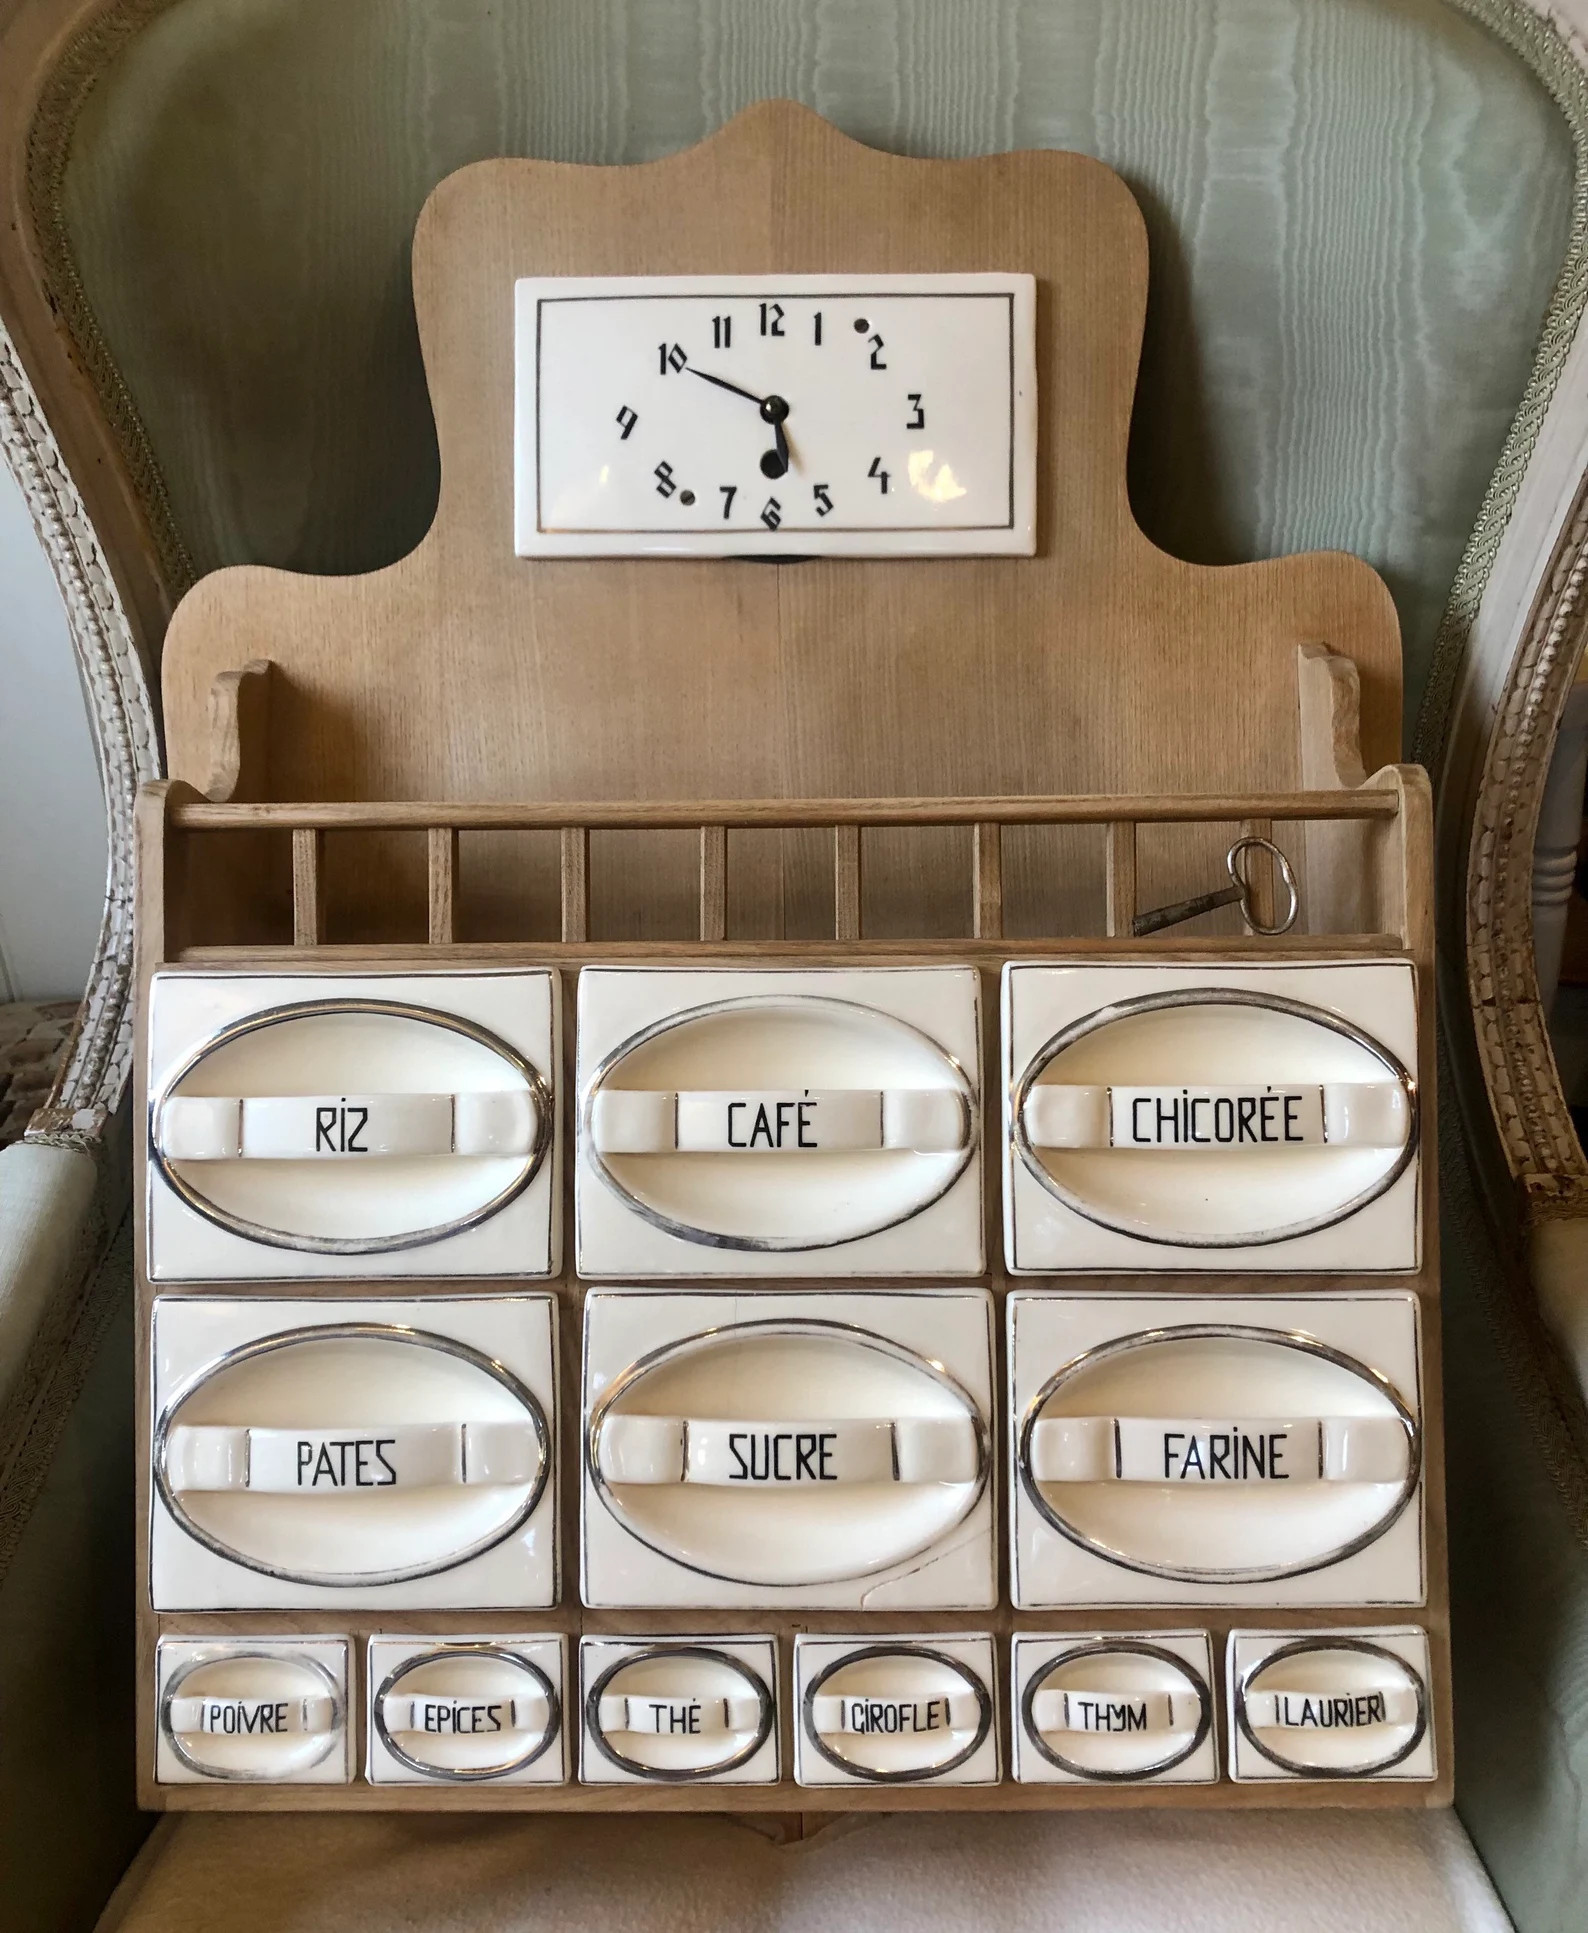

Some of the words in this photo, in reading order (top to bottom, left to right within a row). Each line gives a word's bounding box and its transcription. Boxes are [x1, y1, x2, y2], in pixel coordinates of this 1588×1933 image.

[711, 315, 732, 349] 11
[759, 302, 785, 337] 12
[813, 312, 822, 346] 1
[658, 343, 688, 375] 10
[868, 333, 887, 371] 2
[615, 405, 639, 441] 9
[906, 393, 925, 430] 3
[653, 460, 677, 499] 8
[867, 456, 890, 495] 4
[719, 486, 738, 520] 7
[760, 498, 781, 531] 6
[813, 484, 834, 517] 5
[727, 1089, 818, 1149] CAFÉ
[297, 1439, 397, 1487] PATES
[728, 1433, 838, 1481] SUCRE
[648, 1698, 702, 1735] THÉ
